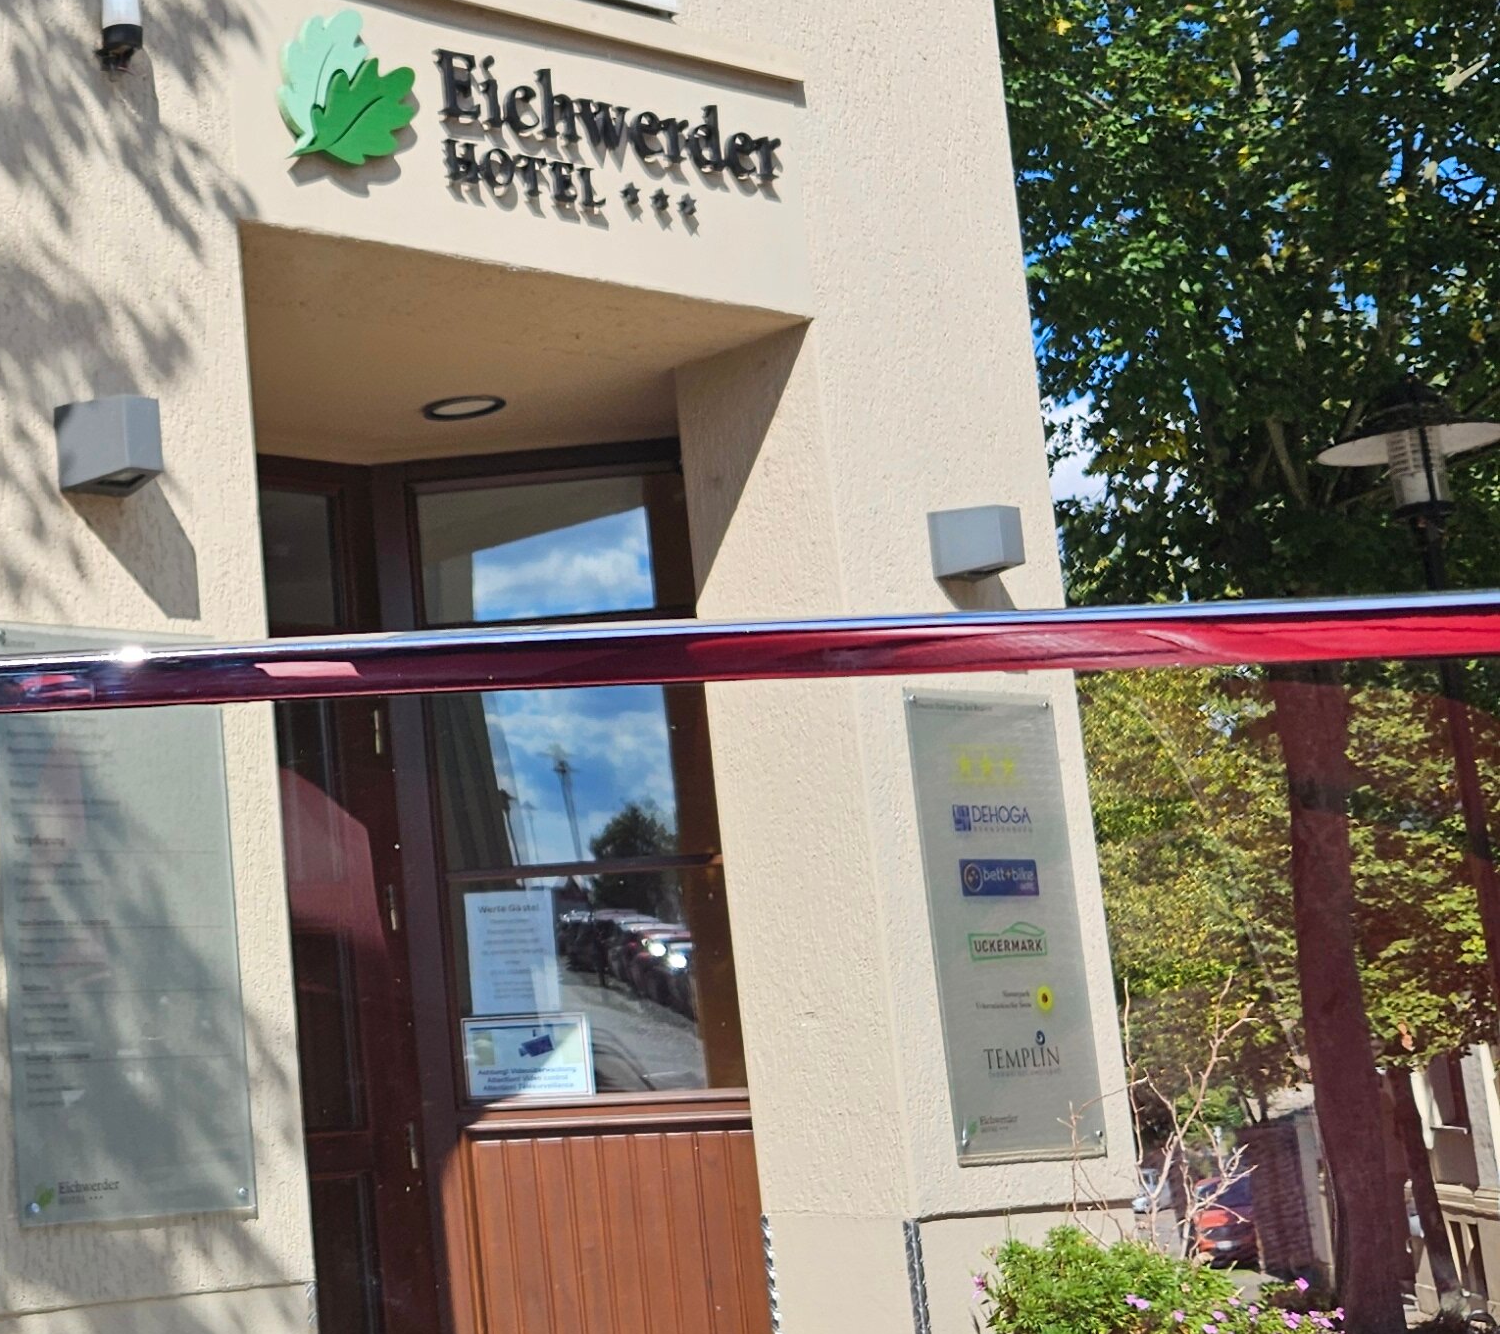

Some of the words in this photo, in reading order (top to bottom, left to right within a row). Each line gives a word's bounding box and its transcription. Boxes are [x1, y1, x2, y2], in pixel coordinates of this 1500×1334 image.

[434, 49, 782, 183] Eichwerder
[442, 138, 607, 208] HOTEL
[971, 805, 1032, 824] DEHOGA
[973, 939, 1044, 953] UCKERMARK
[983, 1046, 1061, 1070] TEMPLIN
[58, 1178, 120, 1195] Eichwerder
